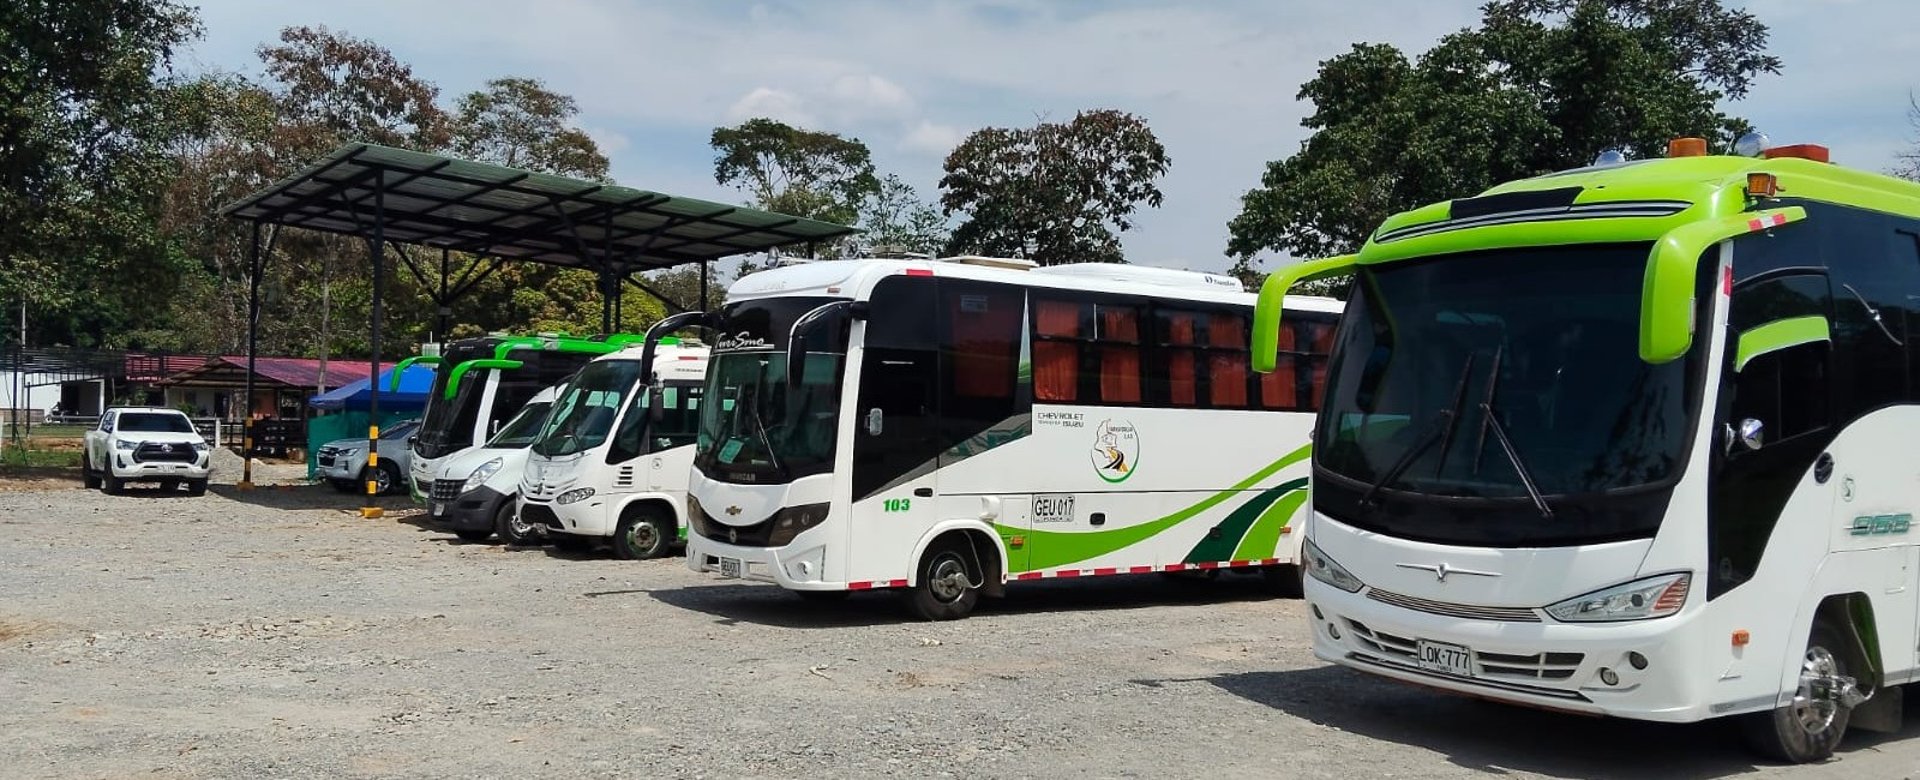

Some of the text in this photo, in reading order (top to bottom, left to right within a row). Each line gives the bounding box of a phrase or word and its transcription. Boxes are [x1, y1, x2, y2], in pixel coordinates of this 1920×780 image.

[1037, 412, 1084, 420] CHEVROLET
[883, 499, 910, 512] 103
[1035, 497, 1074, 516] GEU 017
